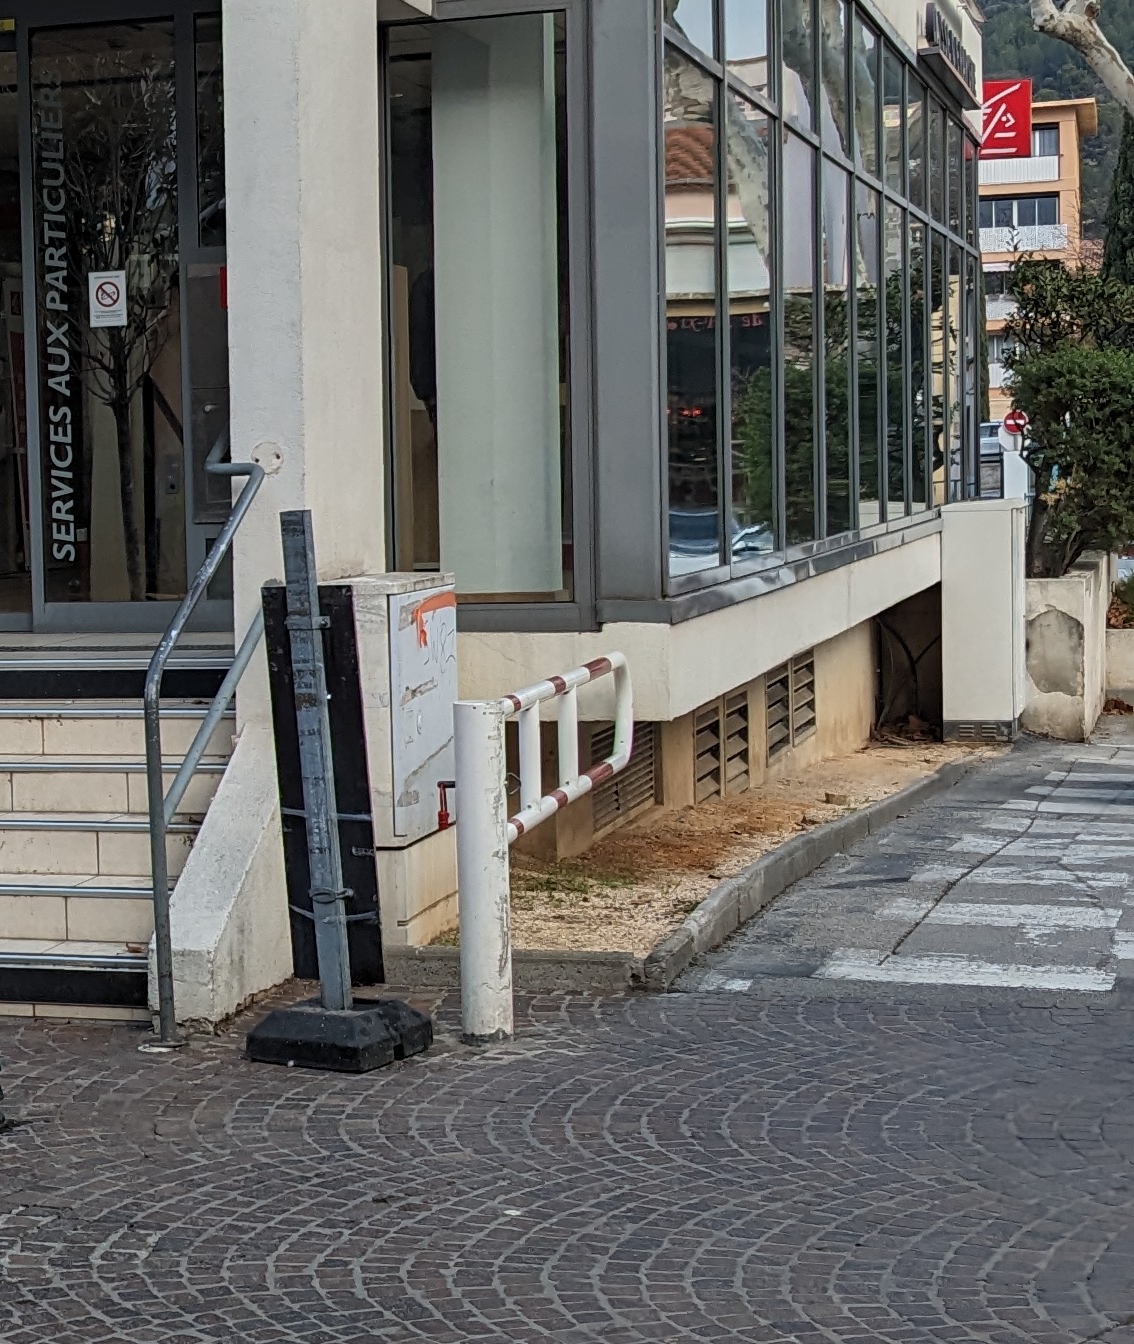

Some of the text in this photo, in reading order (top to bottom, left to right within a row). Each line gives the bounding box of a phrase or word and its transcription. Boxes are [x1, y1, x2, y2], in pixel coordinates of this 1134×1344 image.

[39, 70, 76, 562] SERVICES AUX PARTICULIERS
